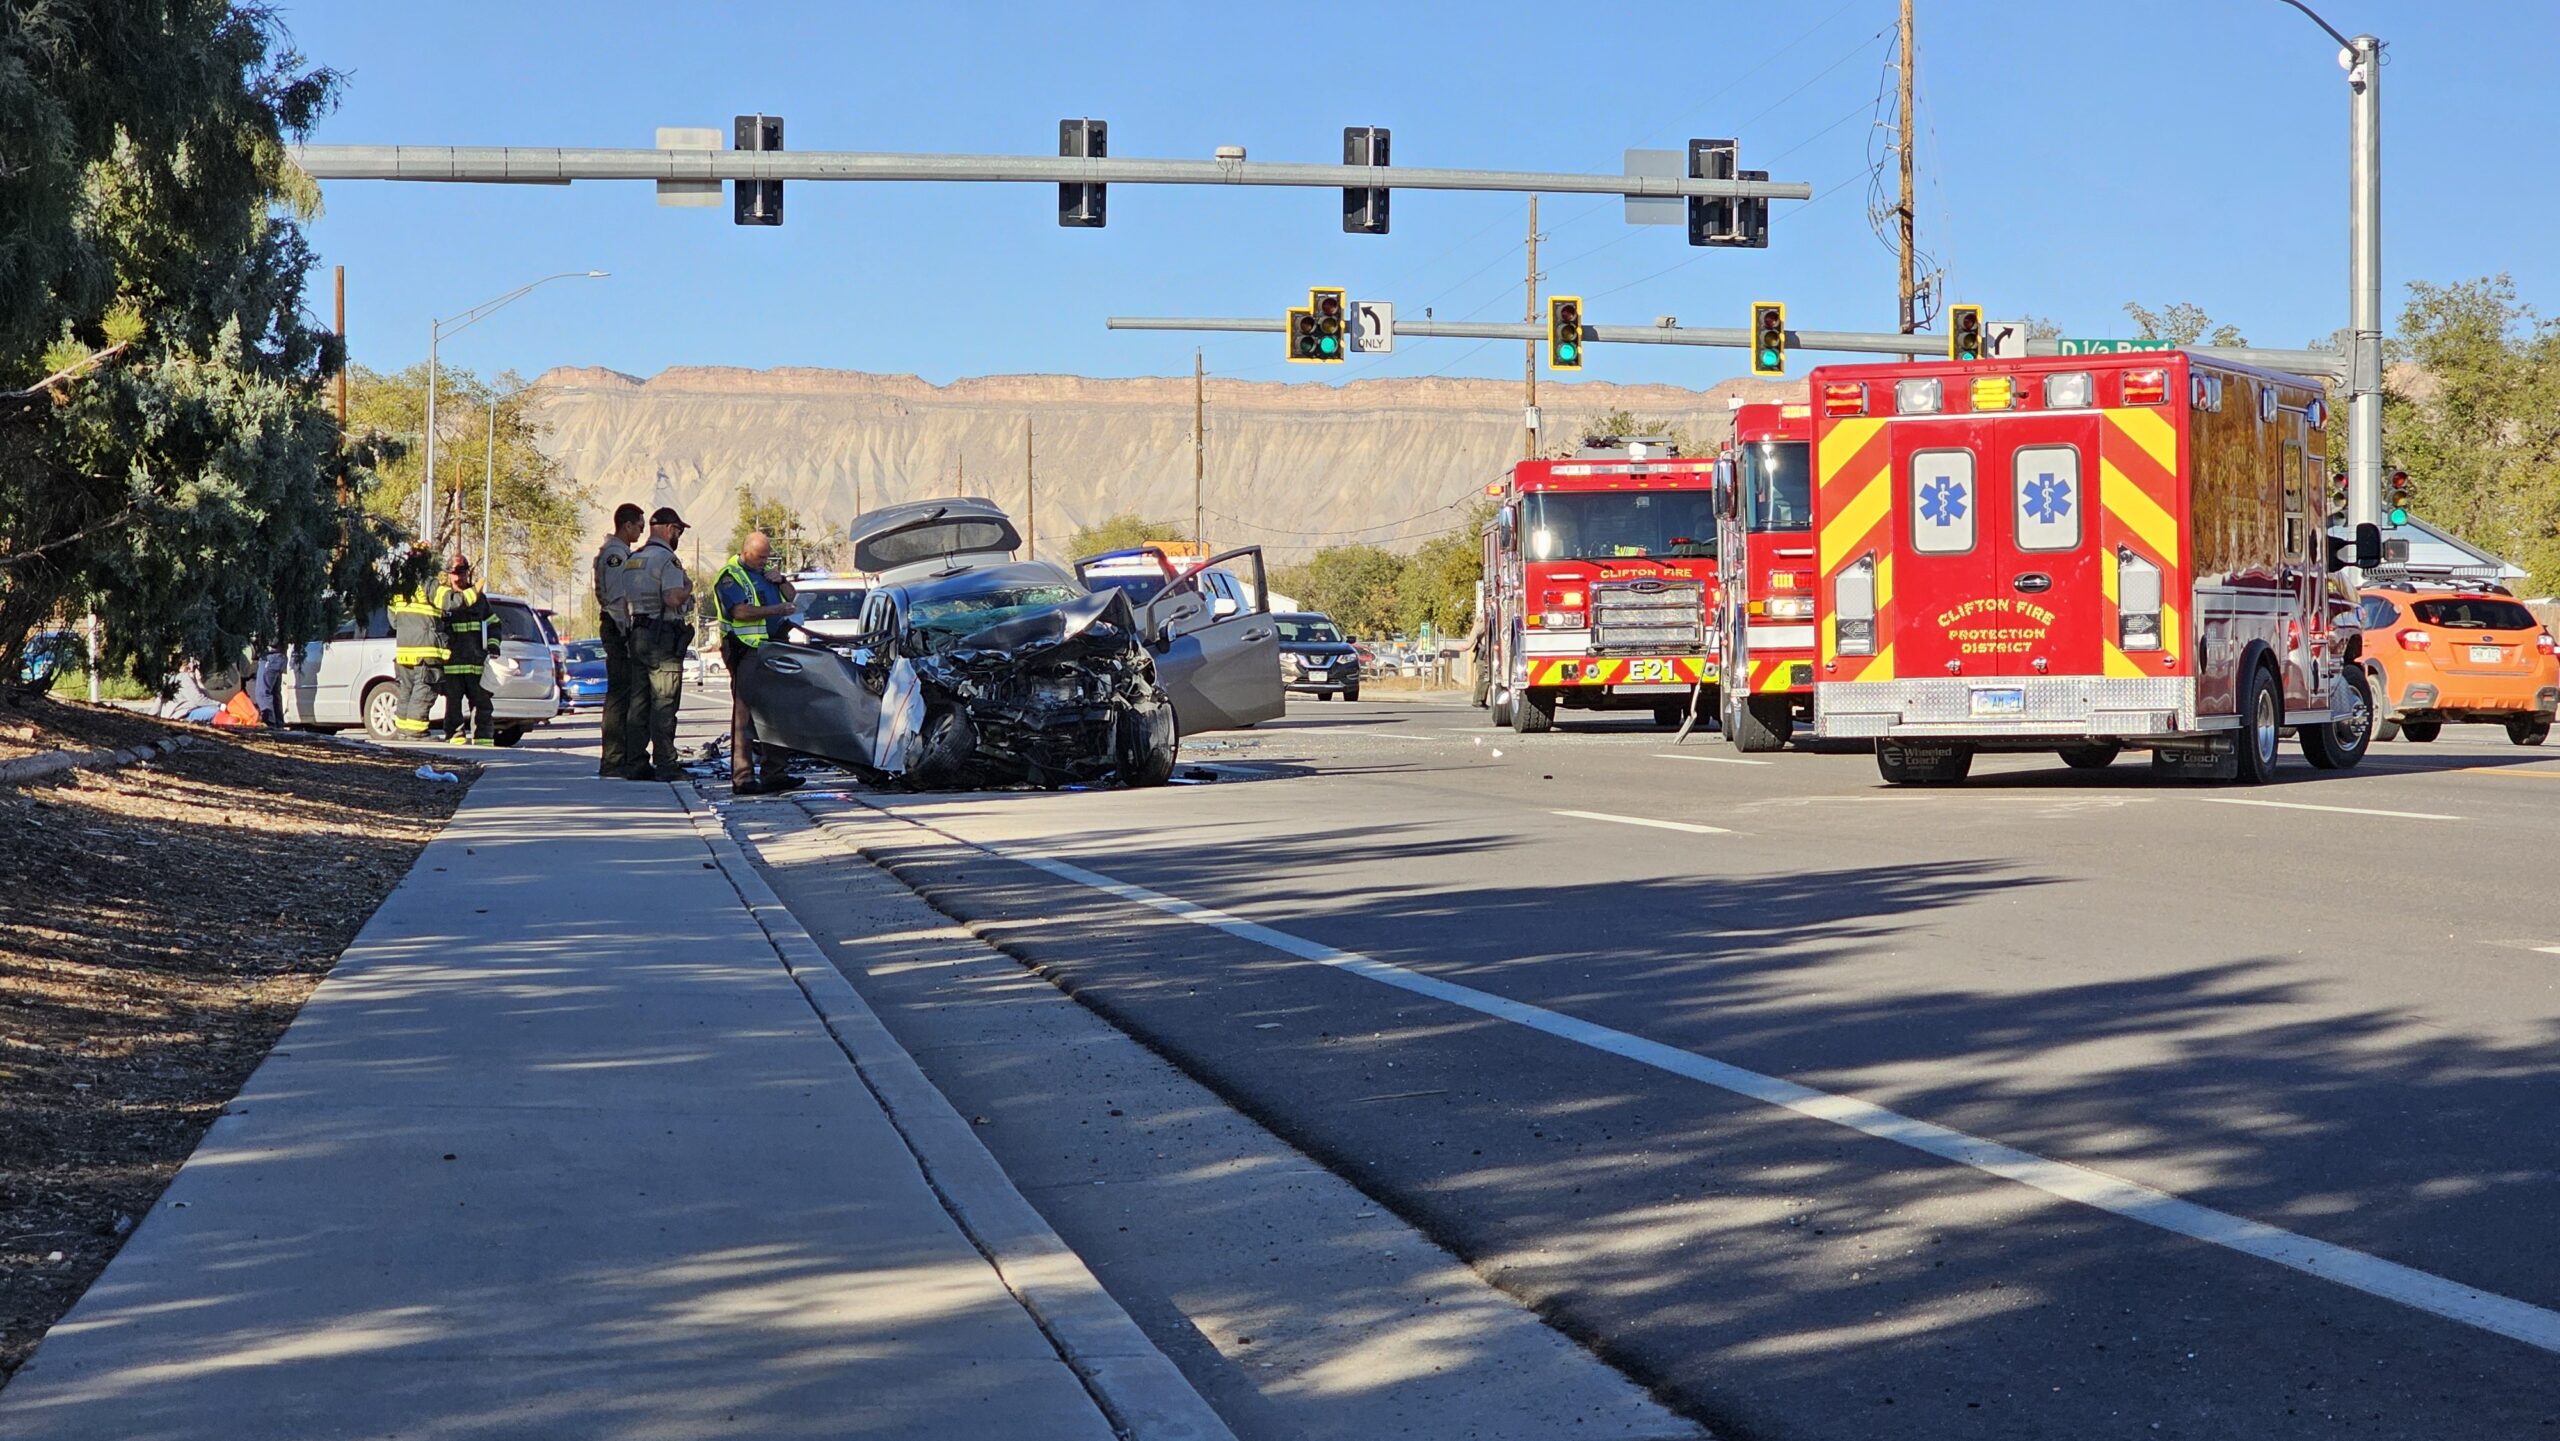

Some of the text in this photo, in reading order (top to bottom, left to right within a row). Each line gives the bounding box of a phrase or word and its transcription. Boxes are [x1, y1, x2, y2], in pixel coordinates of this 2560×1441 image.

[1358, 338, 1384, 348] ONLY
[2062, 341, 2078, 356] D
[1600, 568, 1693, 579] CLIFTON FIRE
[1937, 599, 2056, 627] CLIFTON FIRE
[1948, 628, 2046, 640] PROTECTION
[1961, 641, 2033, 654] DISTRICT
[1629, 659, 1675, 681] E21
[1904, 747, 1952, 757] Wheeled
[1905, 756, 1939, 765] Coach
